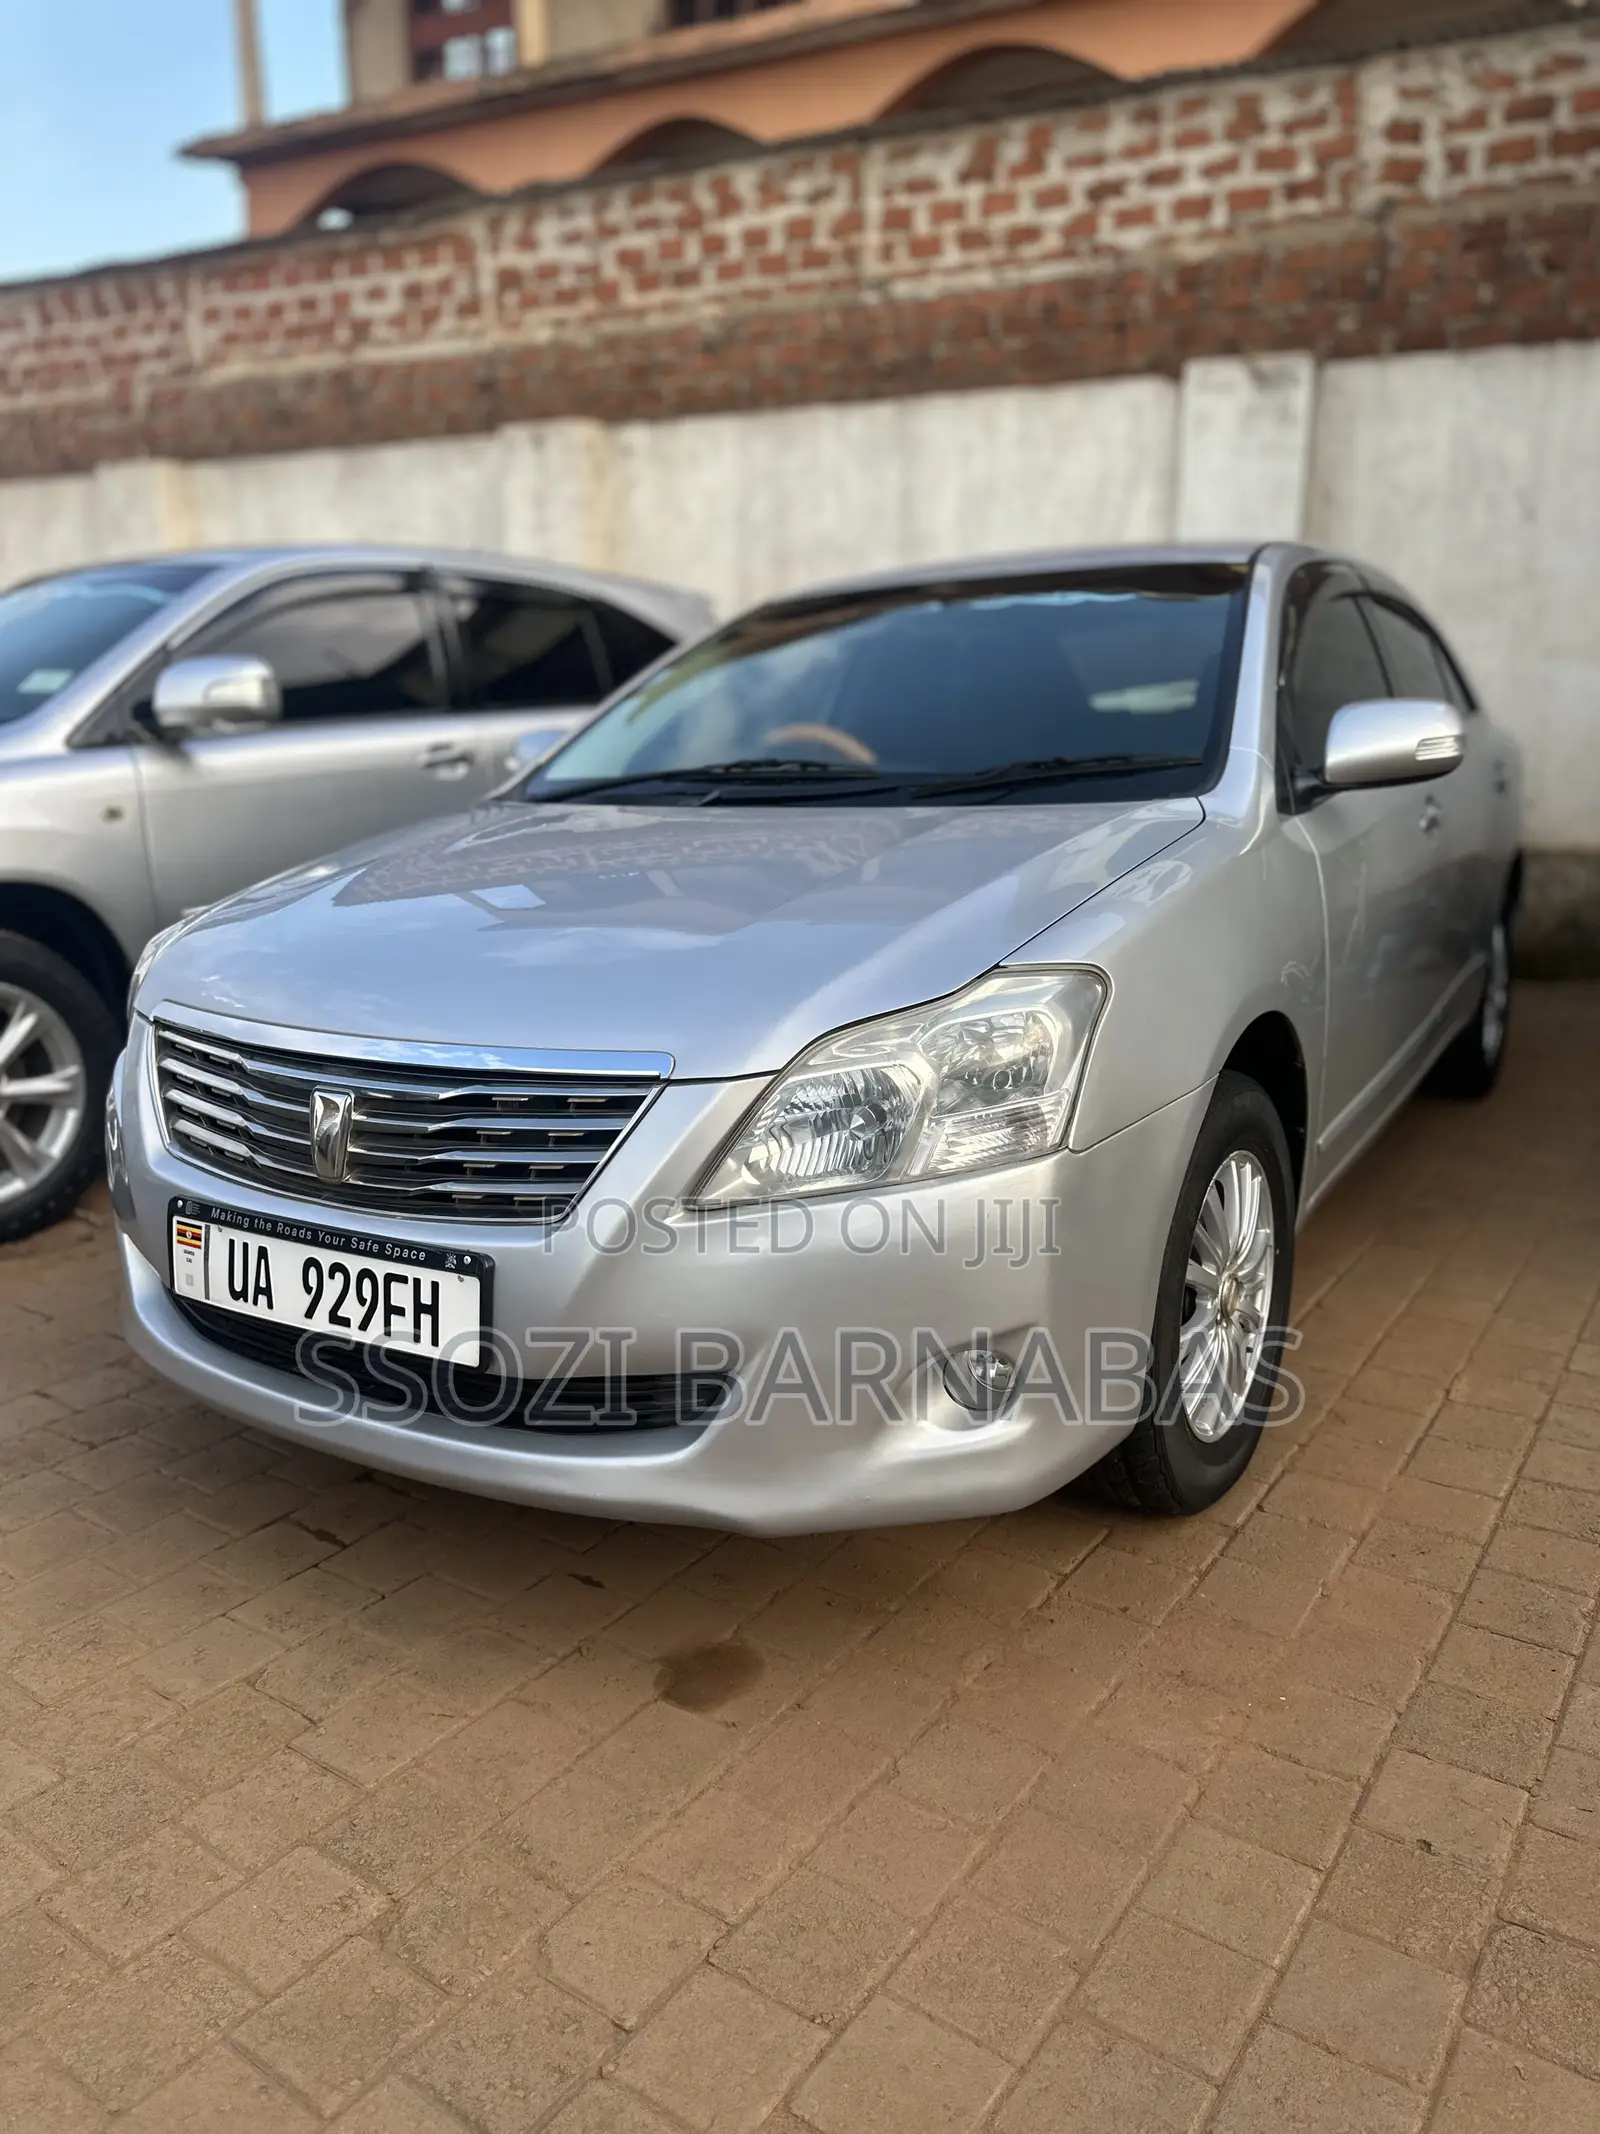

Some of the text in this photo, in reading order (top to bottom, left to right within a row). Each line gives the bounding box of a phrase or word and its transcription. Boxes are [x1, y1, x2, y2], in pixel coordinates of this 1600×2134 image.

[210, 1207, 250, 1229] Making
[254, 1218, 272, 1231] the
[276, 1222, 312, 1240] Roads
[318, 1231, 346, 1246] Your
[350, 1237, 379, 1253] Safe
[384, 1243, 426, 1260] Space
[228, 1237, 440, 1348] UA 929FH
